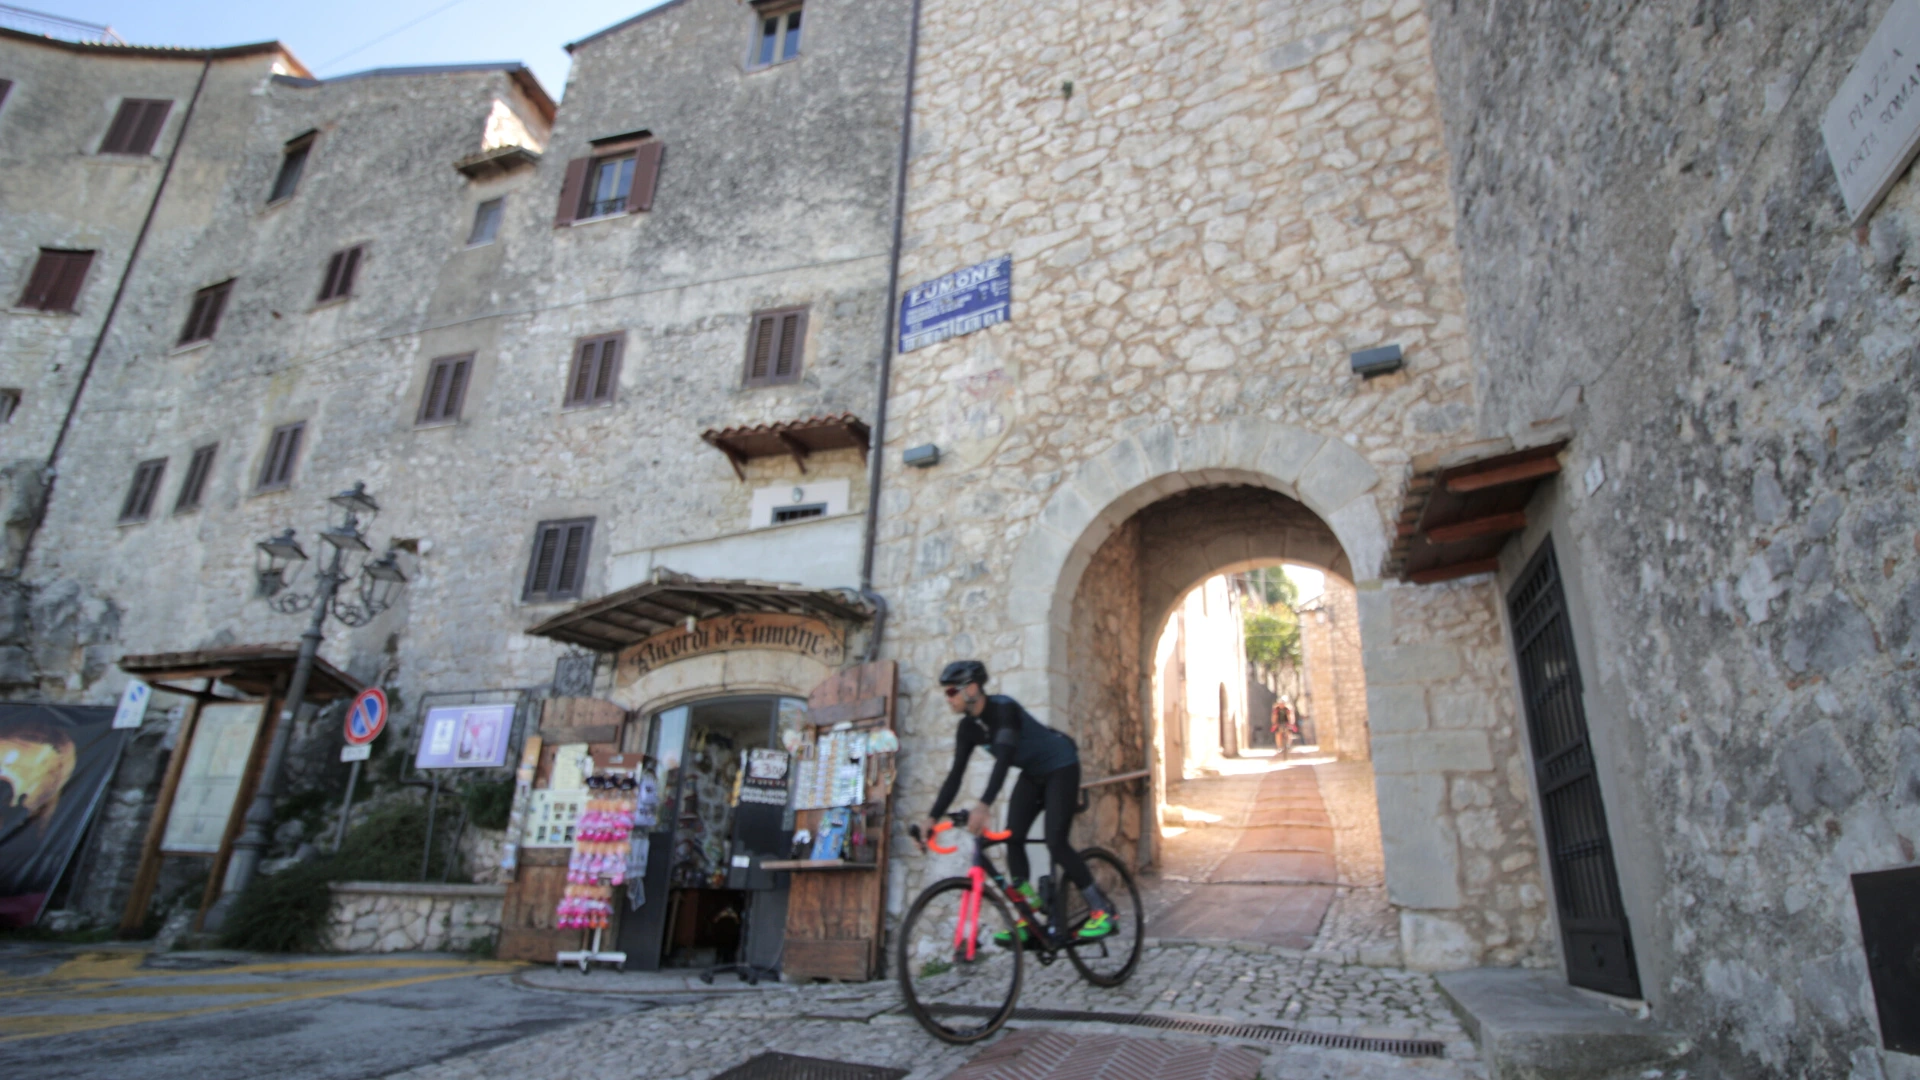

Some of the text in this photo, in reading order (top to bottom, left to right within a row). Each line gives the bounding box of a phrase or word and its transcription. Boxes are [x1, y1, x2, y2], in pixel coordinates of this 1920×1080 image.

[1847, 48, 1904, 130] PIAZZA
[1841, 131, 1880, 183] PORTA
[715, 627, 729, 645] di
